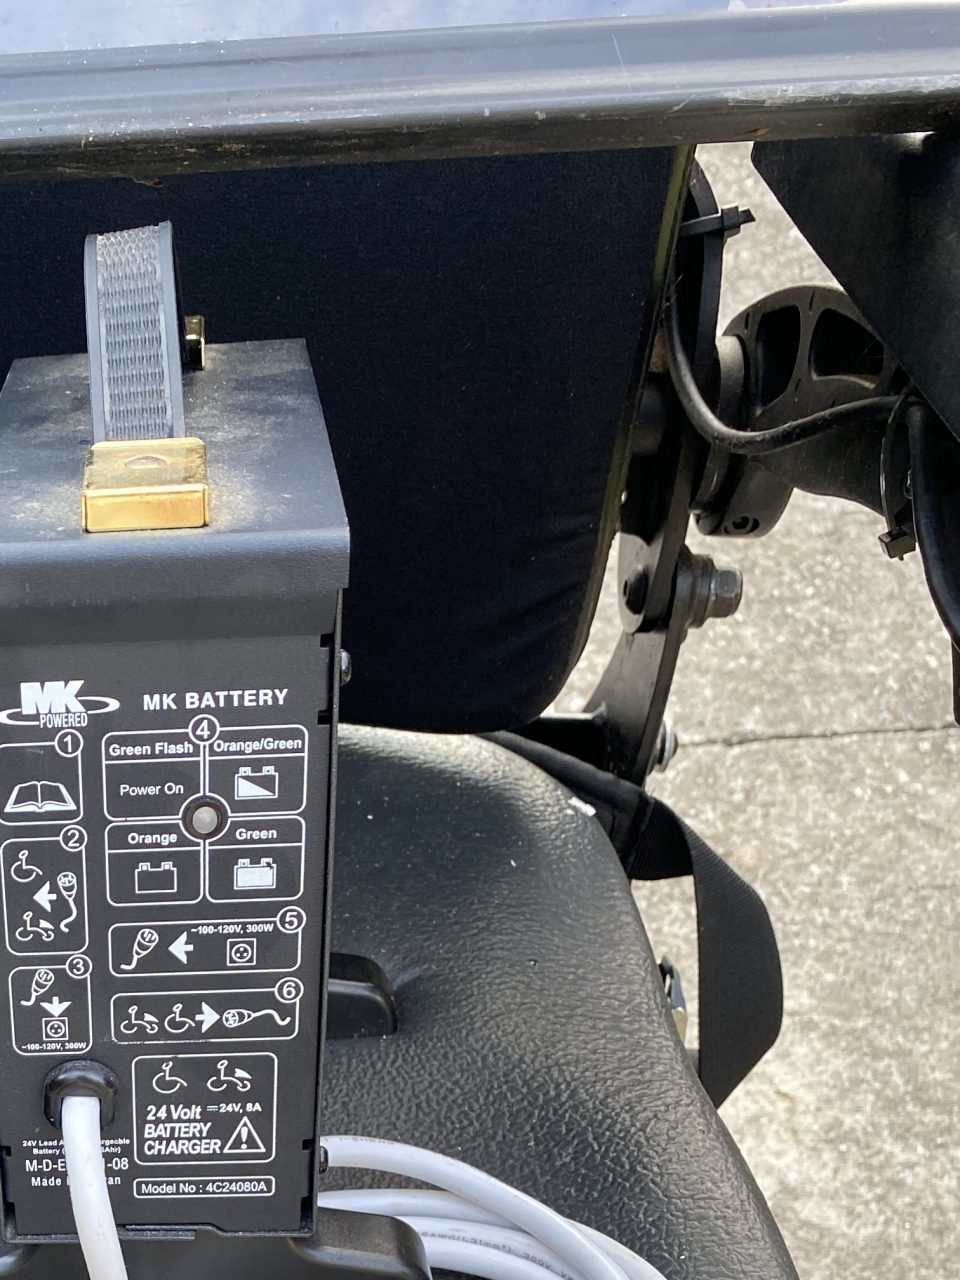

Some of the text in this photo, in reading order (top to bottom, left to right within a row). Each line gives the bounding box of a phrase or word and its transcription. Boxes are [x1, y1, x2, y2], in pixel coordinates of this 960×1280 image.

[20, 680, 86, 715] MK
[143, 689, 289, 710] MK BATTERY
[40, 713, 88, 728] POWERED
[195, 719, 211, 739] 4
[109, 741, 194, 756] Green Flash
[213, 738, 302, 755] Orange/Green
[120, 782, 184, 796] Power On
[127, 832, 178, 847] Orange
[235, 828, 277, 841] Green
[246, 923, 274, 933] 300W
[284, 911, 298, 930] 5
[282, 981, 296, 999] 6
[65, 1042, 87, 1050] 300W
[146, 1104, 202, 1121] 24 Volt
[246, 1102, 262, 1112] 8A
[144, 1122, 212, 1138] BATTERY
[39, 1139, 58, 1147] Lead
[144, 1139, 222, 1155] CHARGER
[33, 1148, 61, 1156] Battery
[32, 1176, 62, 1187] Made
[141, 1183, 176, 1194] Model
[180, 1182, 196, 1193] No
[206, 1181, 268, 1192] 4C24080A
